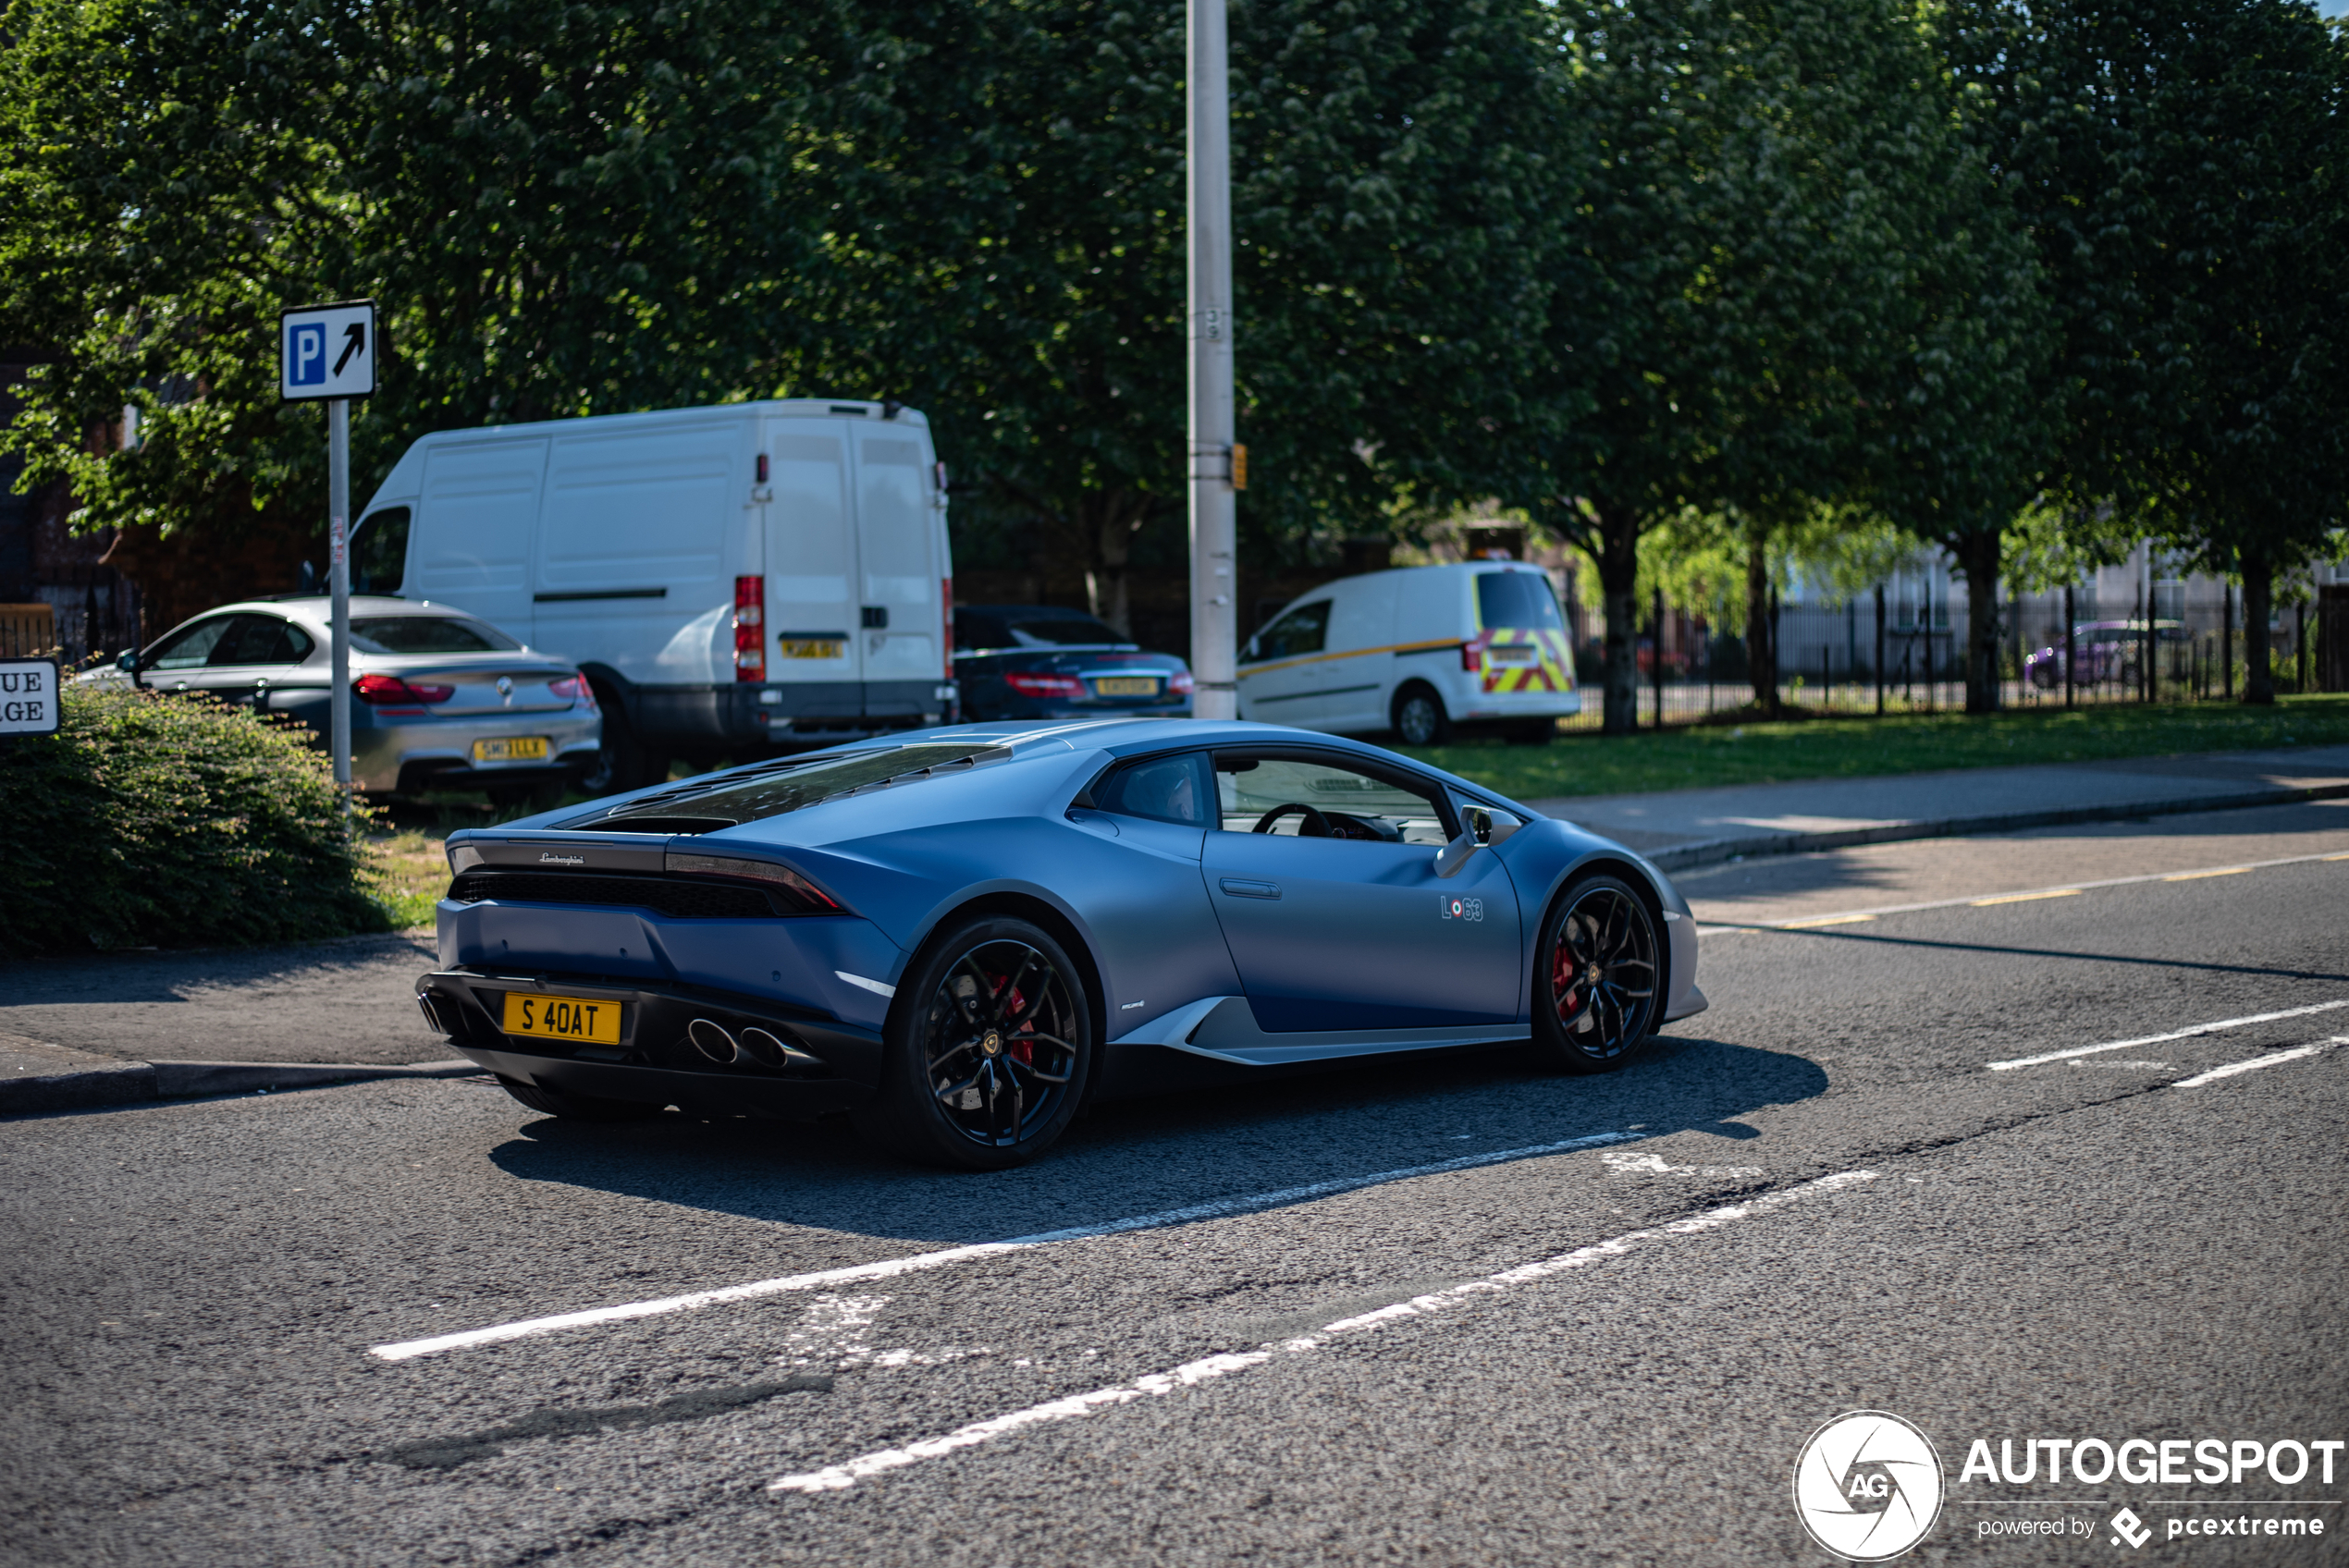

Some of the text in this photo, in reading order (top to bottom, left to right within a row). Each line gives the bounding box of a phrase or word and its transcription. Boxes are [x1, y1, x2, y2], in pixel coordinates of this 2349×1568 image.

[297, 329, 320, 381] P
[0, 702, 43, 722] GE
[539, 851, 584, 865] Lamborghini
[522, 999, 535, 1030] S
